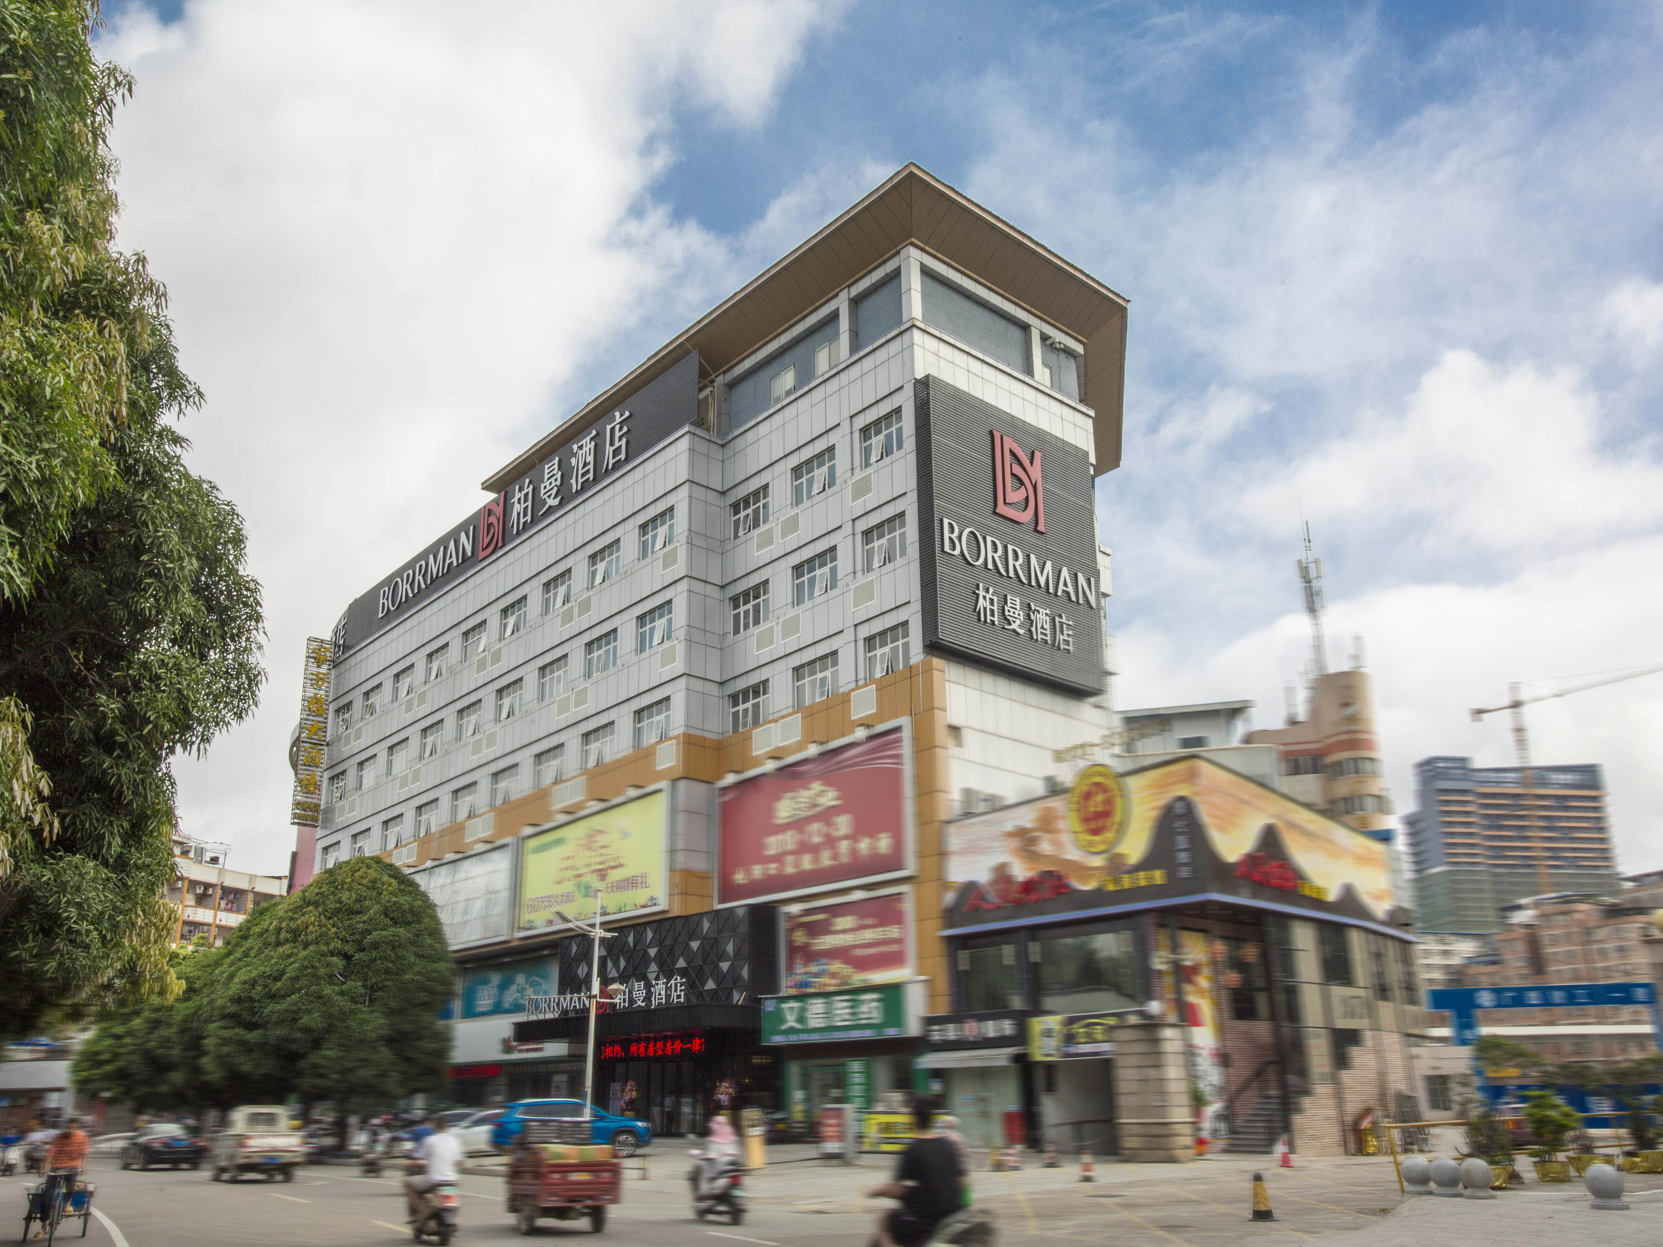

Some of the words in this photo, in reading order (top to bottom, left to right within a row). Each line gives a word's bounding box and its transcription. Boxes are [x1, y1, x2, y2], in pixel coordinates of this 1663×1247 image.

[509, 410, 632, 534] 柏曼酒店
[378, 525, 475, 618] BORRMAN
[942, 517, 1097, 609] BORRMAN
[974, 583, 1074, 653] 柏曼酒店
